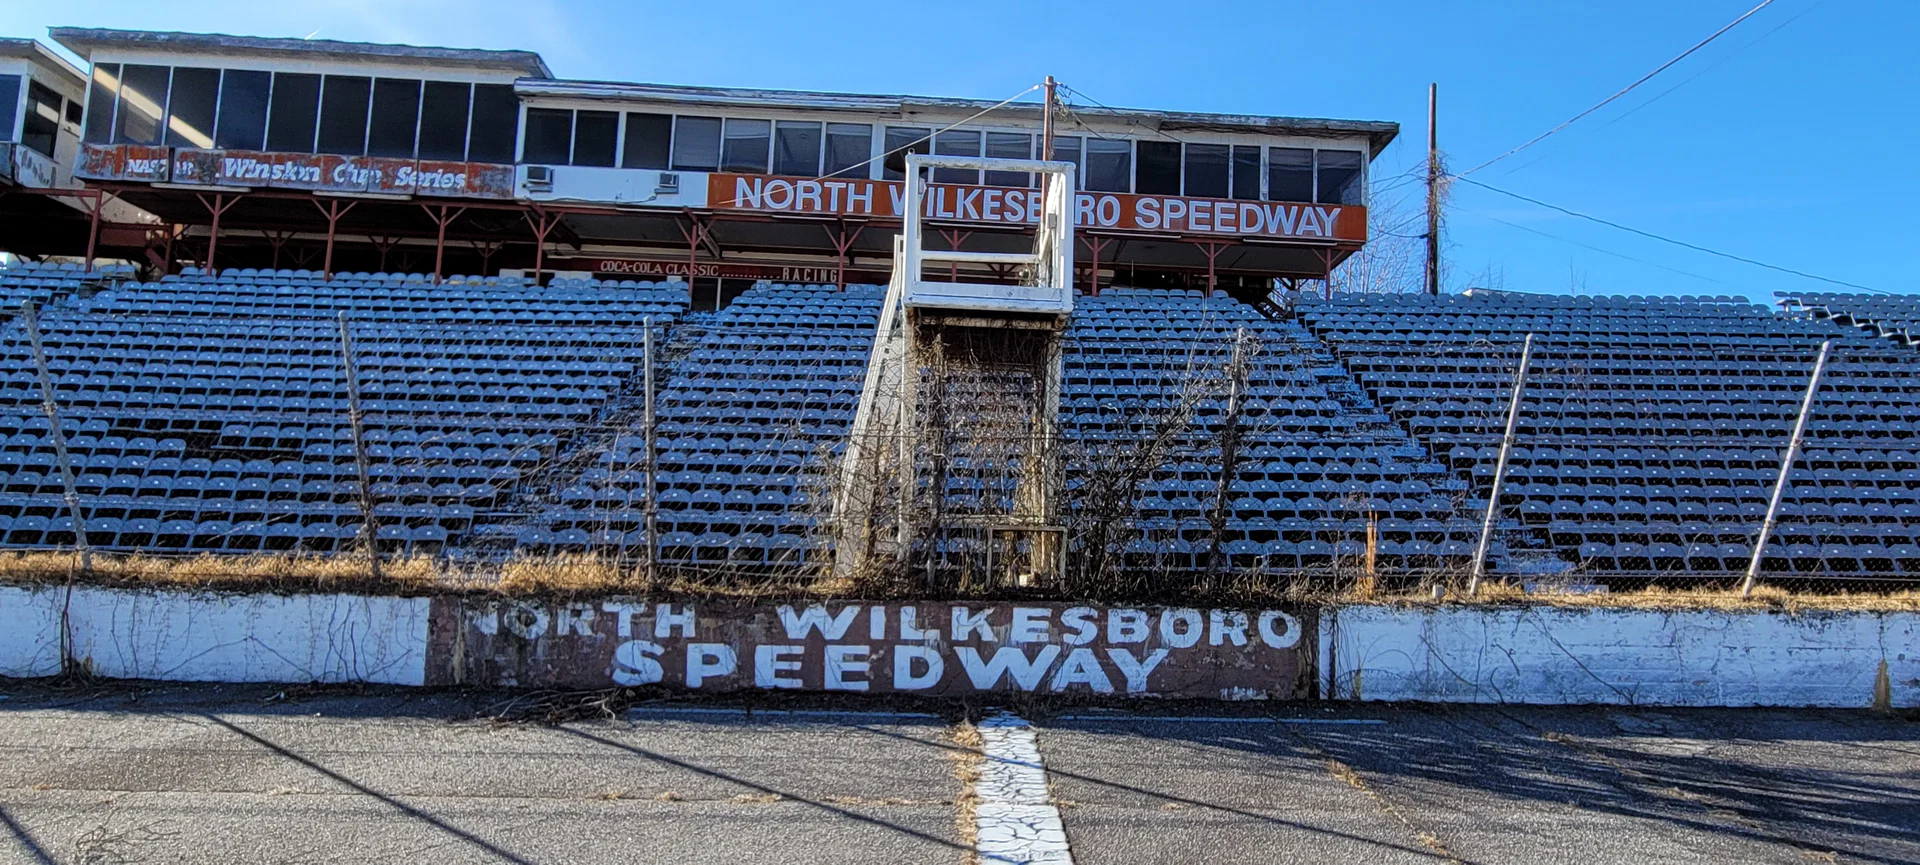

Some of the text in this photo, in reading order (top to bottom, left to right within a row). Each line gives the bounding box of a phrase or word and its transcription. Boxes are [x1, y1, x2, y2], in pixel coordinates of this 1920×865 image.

[223, 157, 320, 182] Winston
[332, 162, 383, 185] Cup
[395, 165, 467, 190] Series
[735, 177, 1342, 237] NORTH WILKESBRO SPEEDWAY
[600, 260, 663, 273] COCA-COLA
[665, 263, 719, 277] CLASSIC
[782, 267, 838, 283] RACING
[464, 600, 1302, 649] NORTH WILKESBORO
[611, 639, 1170, 693] SPEEDWAY
